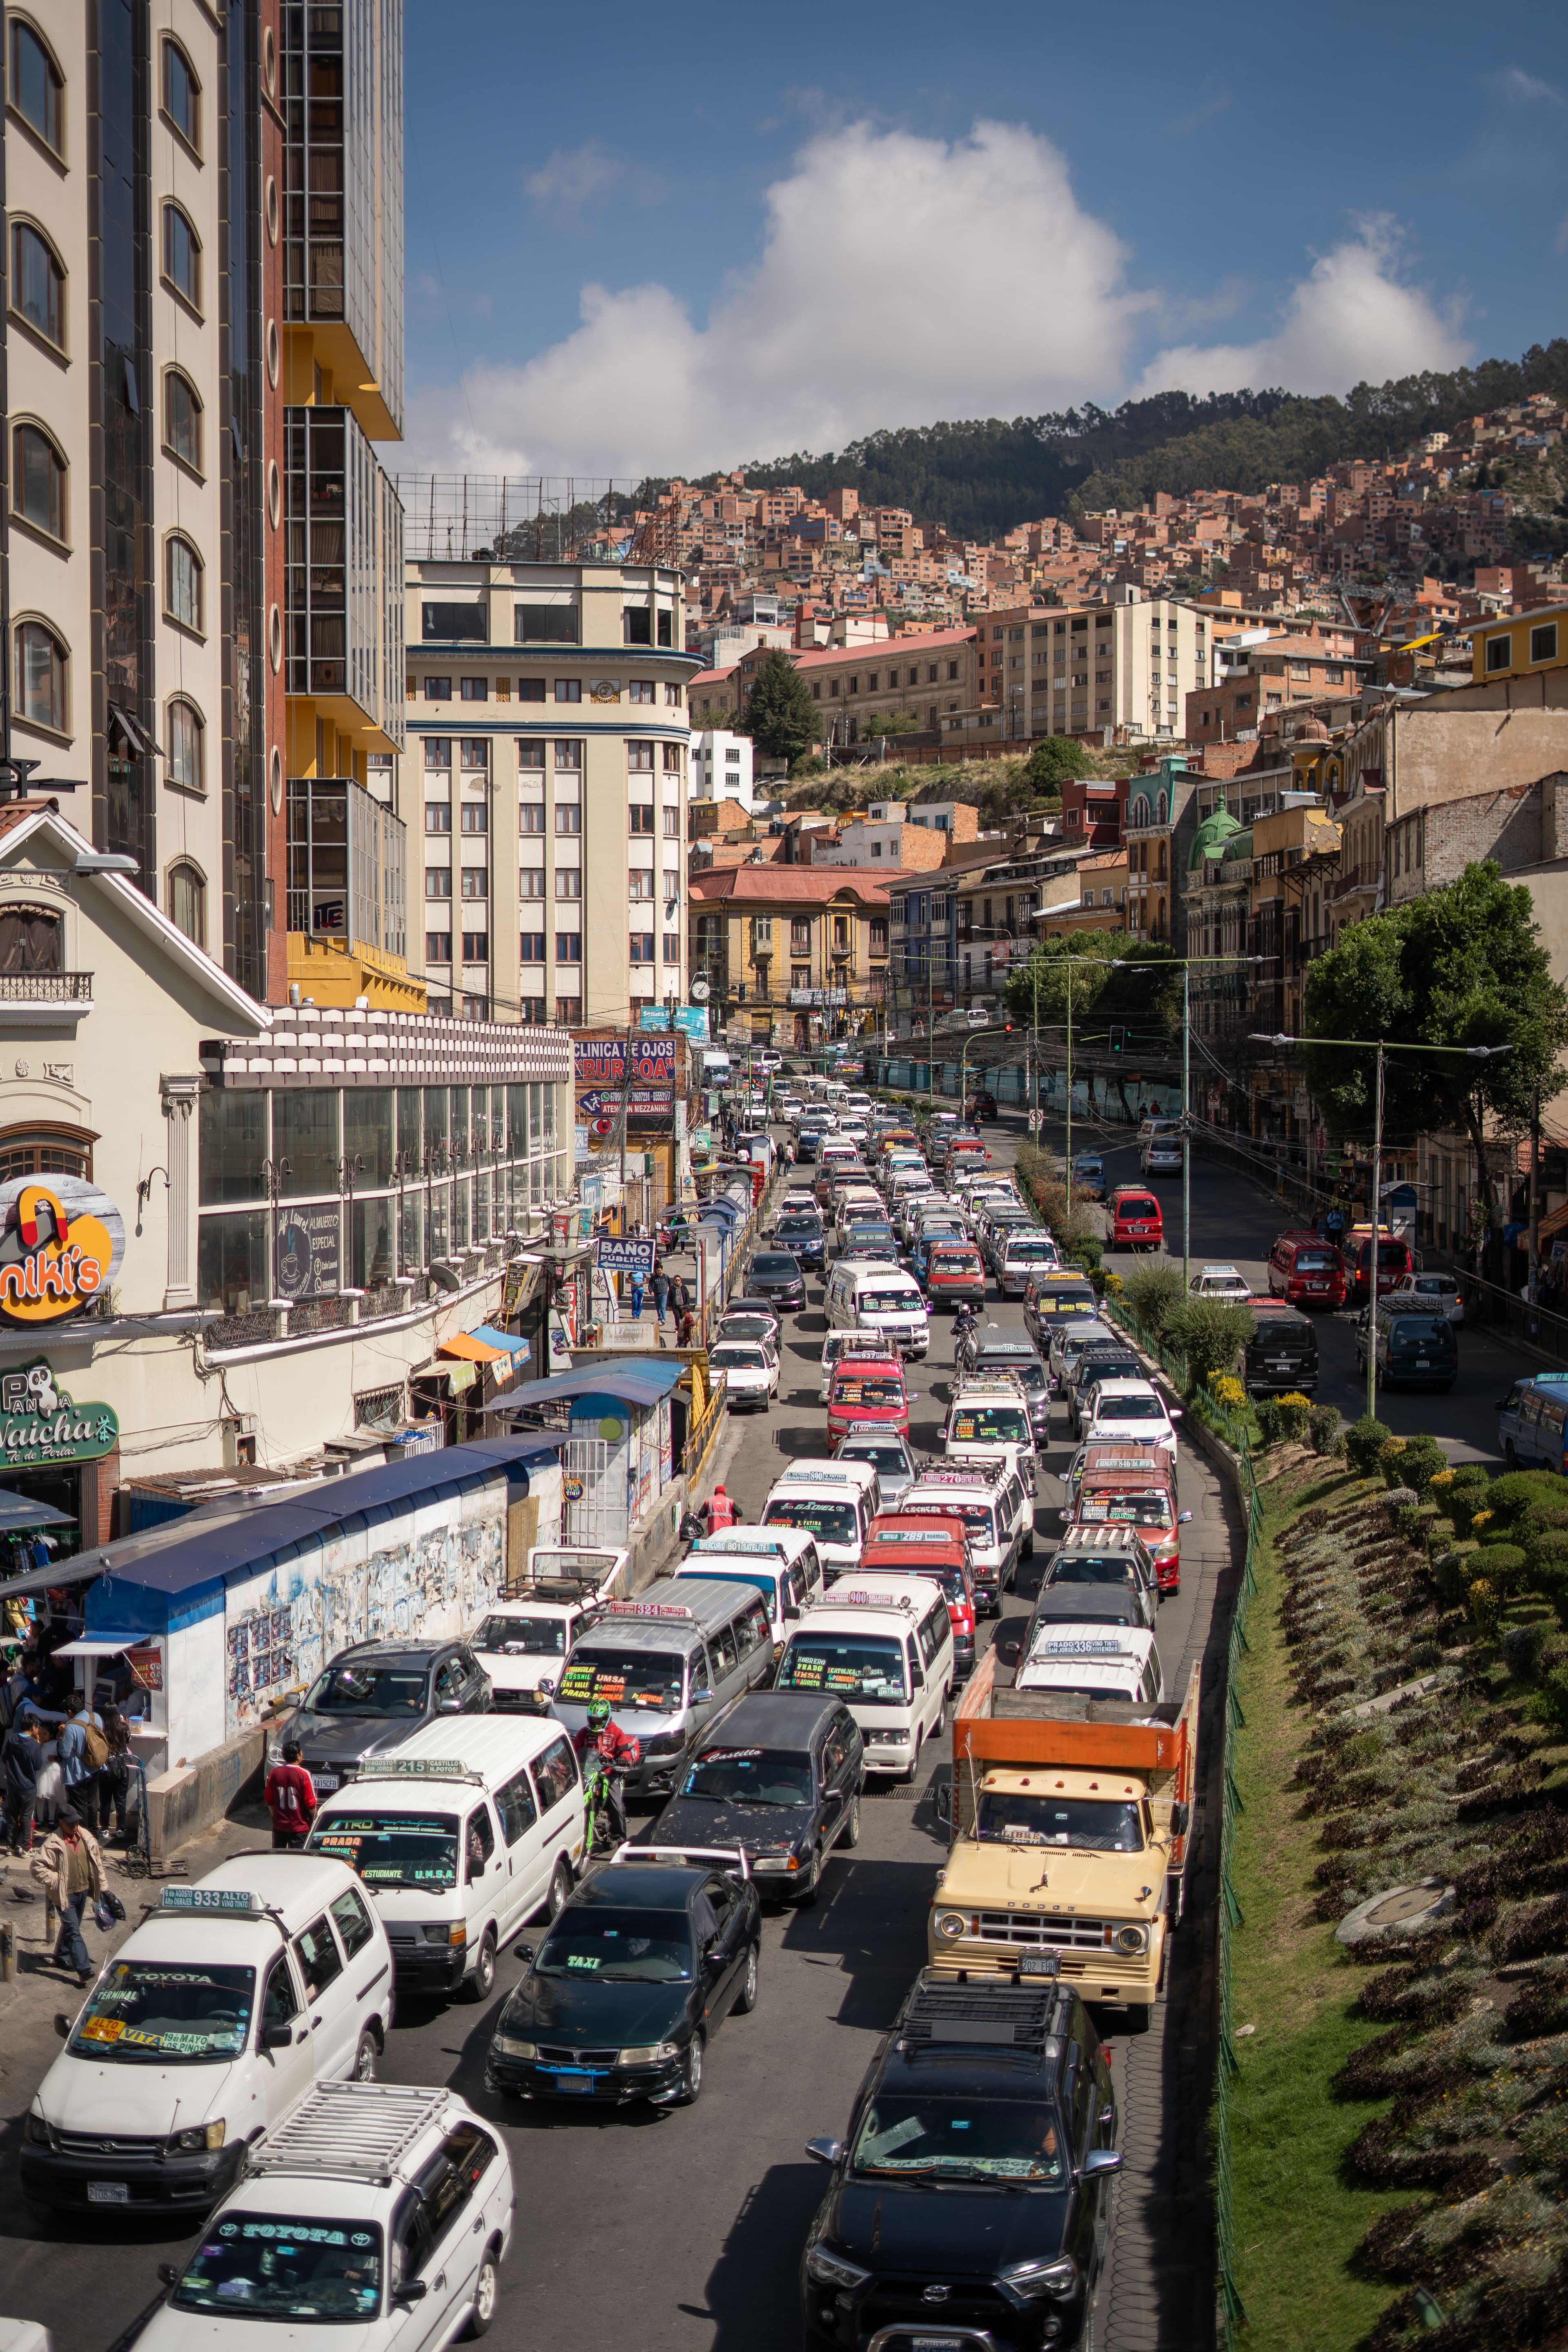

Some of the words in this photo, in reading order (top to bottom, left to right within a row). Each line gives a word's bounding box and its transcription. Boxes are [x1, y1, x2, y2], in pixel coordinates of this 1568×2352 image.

[574, 1042, 620, 1057] CLINICA
[642, 1042, 673, 1056] OJOS
[635, 1104, 668, 1112] MEZZANINE
[1547, 1167, 1564, 1175] pepsi
[290, 1207, 309, 1234] Laurel
[310, 1215, 339, 1230] ALMUERZO
[312, 1235, 336, 1250] ESPECIAL
[601, 1241, 650, 1256] BAÑO
[600, 1254, 649, 1264] PÚBLICO
[0, 1245, 101, 1299] niki's
[3, 1374, 71, 1412] PANA
[95, 1414, 117, 1441] 茶
[24, 1450, 36, 1460] de
[41, 1446, 76, 1458] Perlas
[810, 1472, 822, 1481] 890
[902, 1532, 923, 1541] 289
[701, 1541, 725, 1550] MERCURIO
[727, 1542, 741, 1550] 801
[851, 1592, 866, 1603] 900
[637, 1604, 658, 1615] 324
[1074, 1640, 1091, 1653] 336
[797, 1664, 823, 1672] PRADO
[596, 1674, 625, 1684] UMSA
[794, 1670, 821, 1679] UMSA
[561, 1689, 590, 1698] PRADO
[638, 1694, 663, 1703] AMERICAS
[707, 1749, 762, 1763] Castillo
[398, 1760, 425, 1772] 215
[314, 1779, 336, 1788] 4415CFB
[277, 1786, 296, 1810] 16
[341, 1820, 373, 1829] TRD
[1002, 1831, 1040, 1840] LIBRE
[414, 1870, 455, 1879] U.M.S.A.
[194, 1891, 220, 1907] 933
[222, 1891, 249, 1901] ALTO
[235, 1900, 248, 1908] TINTO
[1007, 1901, 1075, 1911] DODGE
[568, 1956, 600, 1969] TAXI
[1022, 1960, 1036, 1971] 202
[1041, 1961, 1055, 1972] EHH
[133, 1973, 212, 1983] TOYOTA
[98, 1991, 138, 2000] TERMINAL
[93, 2018, 118, 2029] ALTO
[84, 2026, 99, 2035] VINO
[100, 2028, 118, 2039] TINTO
[124, 2029, 163, 2045] VITA
[180, 2035, 207, 2045] MAYO
[242, 2223, 344, 2245] TOYOTA
